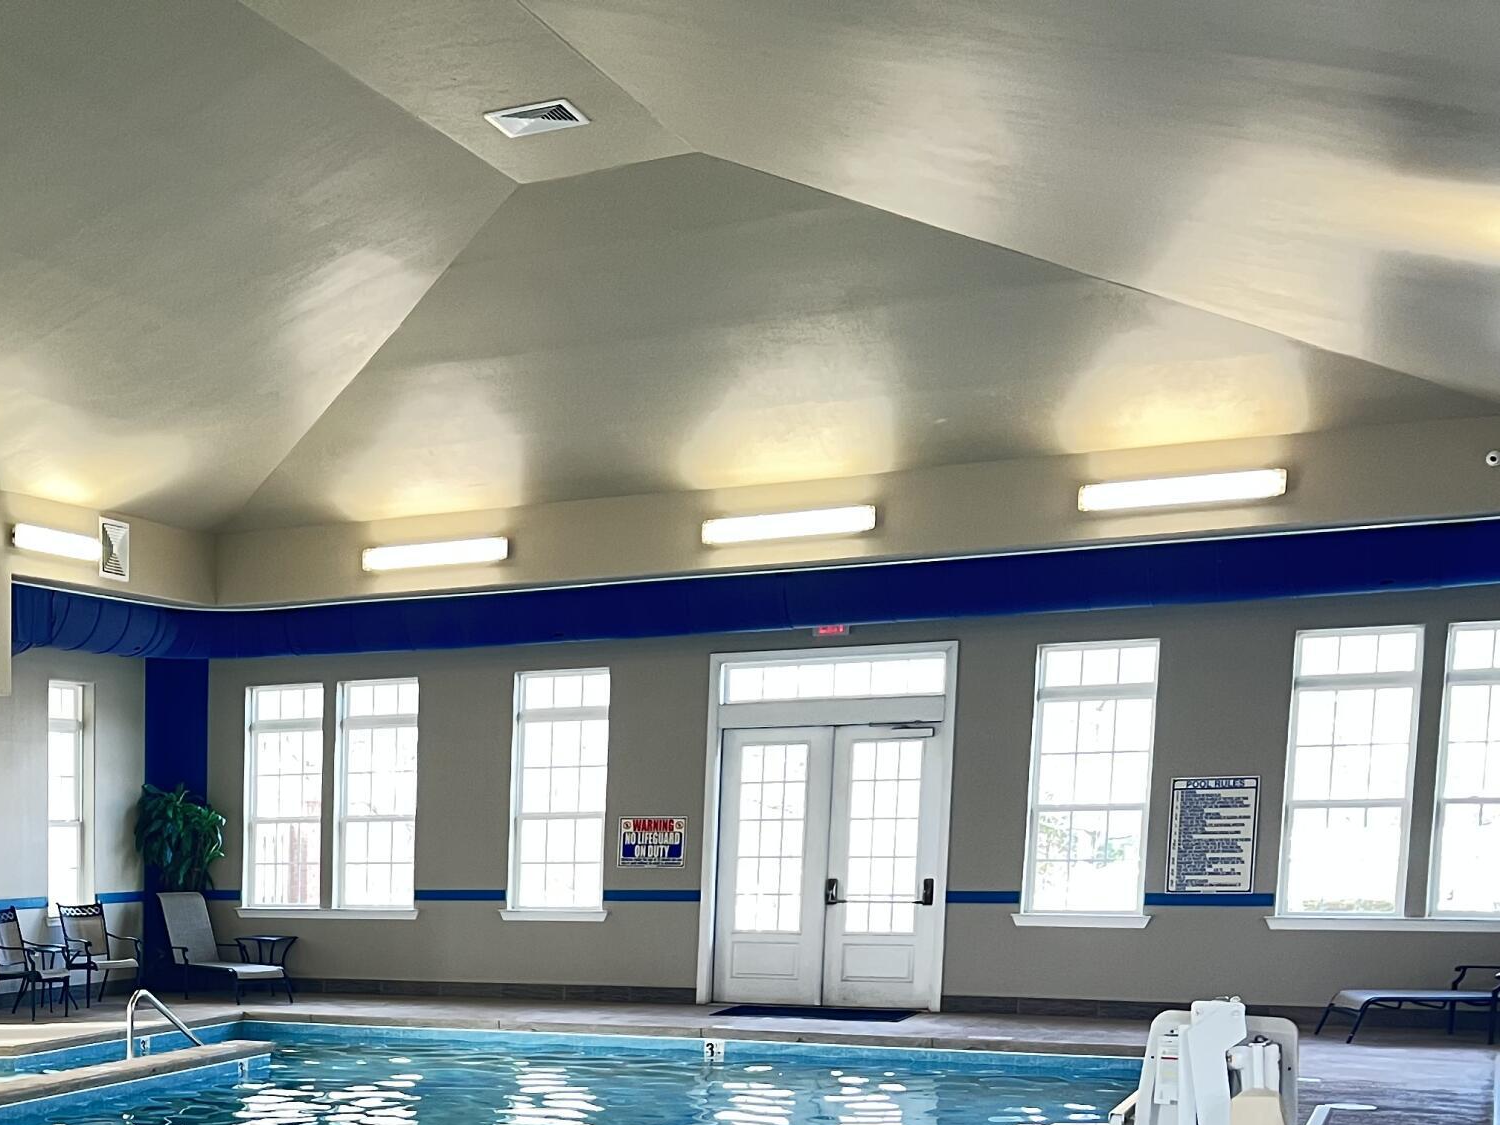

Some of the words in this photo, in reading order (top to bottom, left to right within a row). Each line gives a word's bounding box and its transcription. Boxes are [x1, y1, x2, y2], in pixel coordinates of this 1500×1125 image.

[1187, 780, 1212, 788] POOL
[1215, 780, 1245, 788] RULES
[633, 819, 674, 831] WARNING
[625, 832, 636, 845] NO
[638, 832, 680, 845] LIFEGUARD
[634, 845, 646, 857] ON
[647, 845, 670, 857] DUTY
